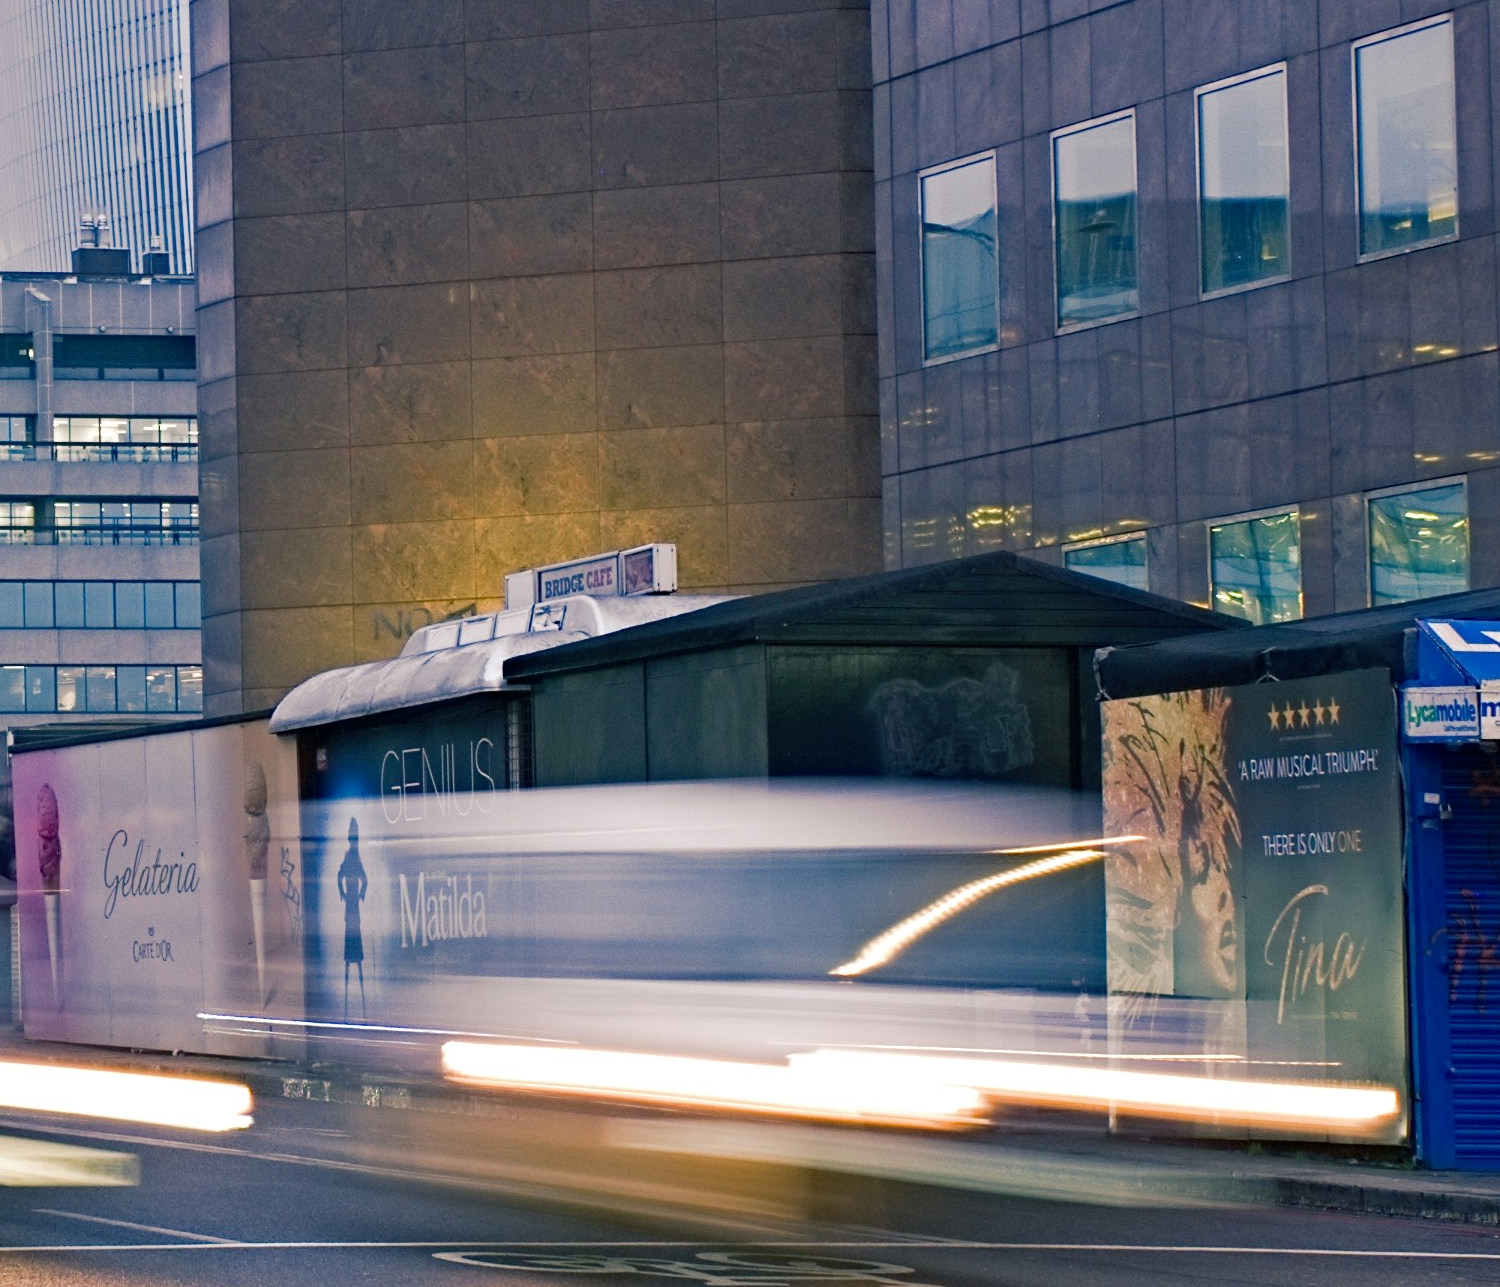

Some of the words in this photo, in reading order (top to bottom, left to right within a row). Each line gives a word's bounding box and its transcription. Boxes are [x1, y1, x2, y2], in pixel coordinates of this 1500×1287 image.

[544, 572, 585, 599] BRIDGE
[586, 566, 614, 590] CAFE
[1407, 697, 1476, 727] Lycamobile
[380, 737, 496, 825] GENIUS
[1250, 757, 1274, 780] RAW
[1276, 753, 1325, 778] MUSICAL
[1262, 833, 1296, 856] THERE
[1297, 833, 1307, 855] IS
[1307, 831, 1337, 854] ONLY
[1337, 830, 1363, 853] ONE
[103, 829, 200, 919] Gelateria
[399, 871, 487, 948] Matilda
[132, 940, 155, 962] CARTE
[1264, 884, 1367, 1025] Tina
